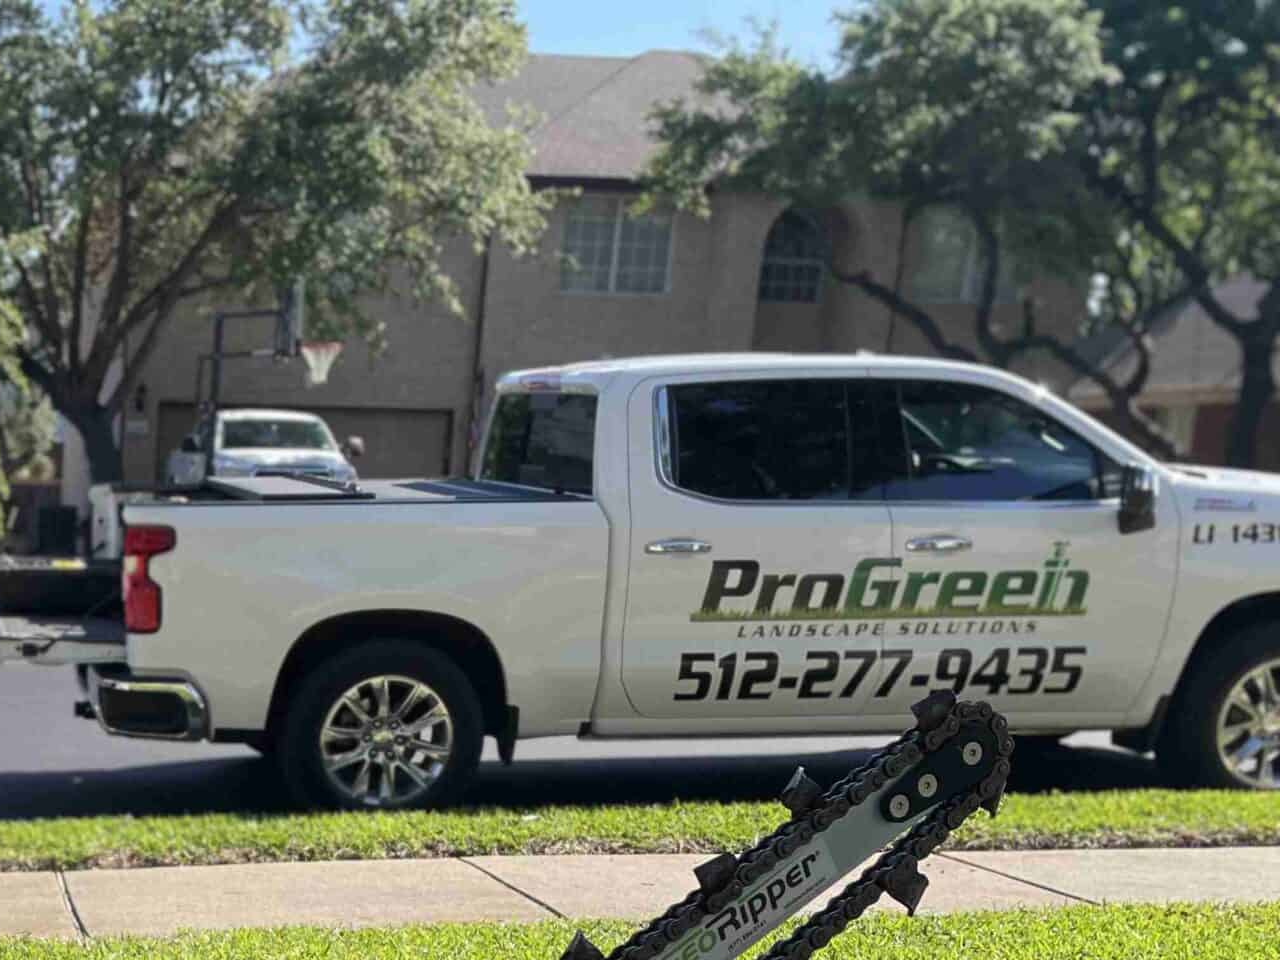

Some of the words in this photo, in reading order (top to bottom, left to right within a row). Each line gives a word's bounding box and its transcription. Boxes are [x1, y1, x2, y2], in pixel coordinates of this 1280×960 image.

[737, 622, 885, 639] LANDSCAPE
[896, 620, 1038, 636] SOLUTIONS
[673, 646, 1087, 701] 512-277-9435
